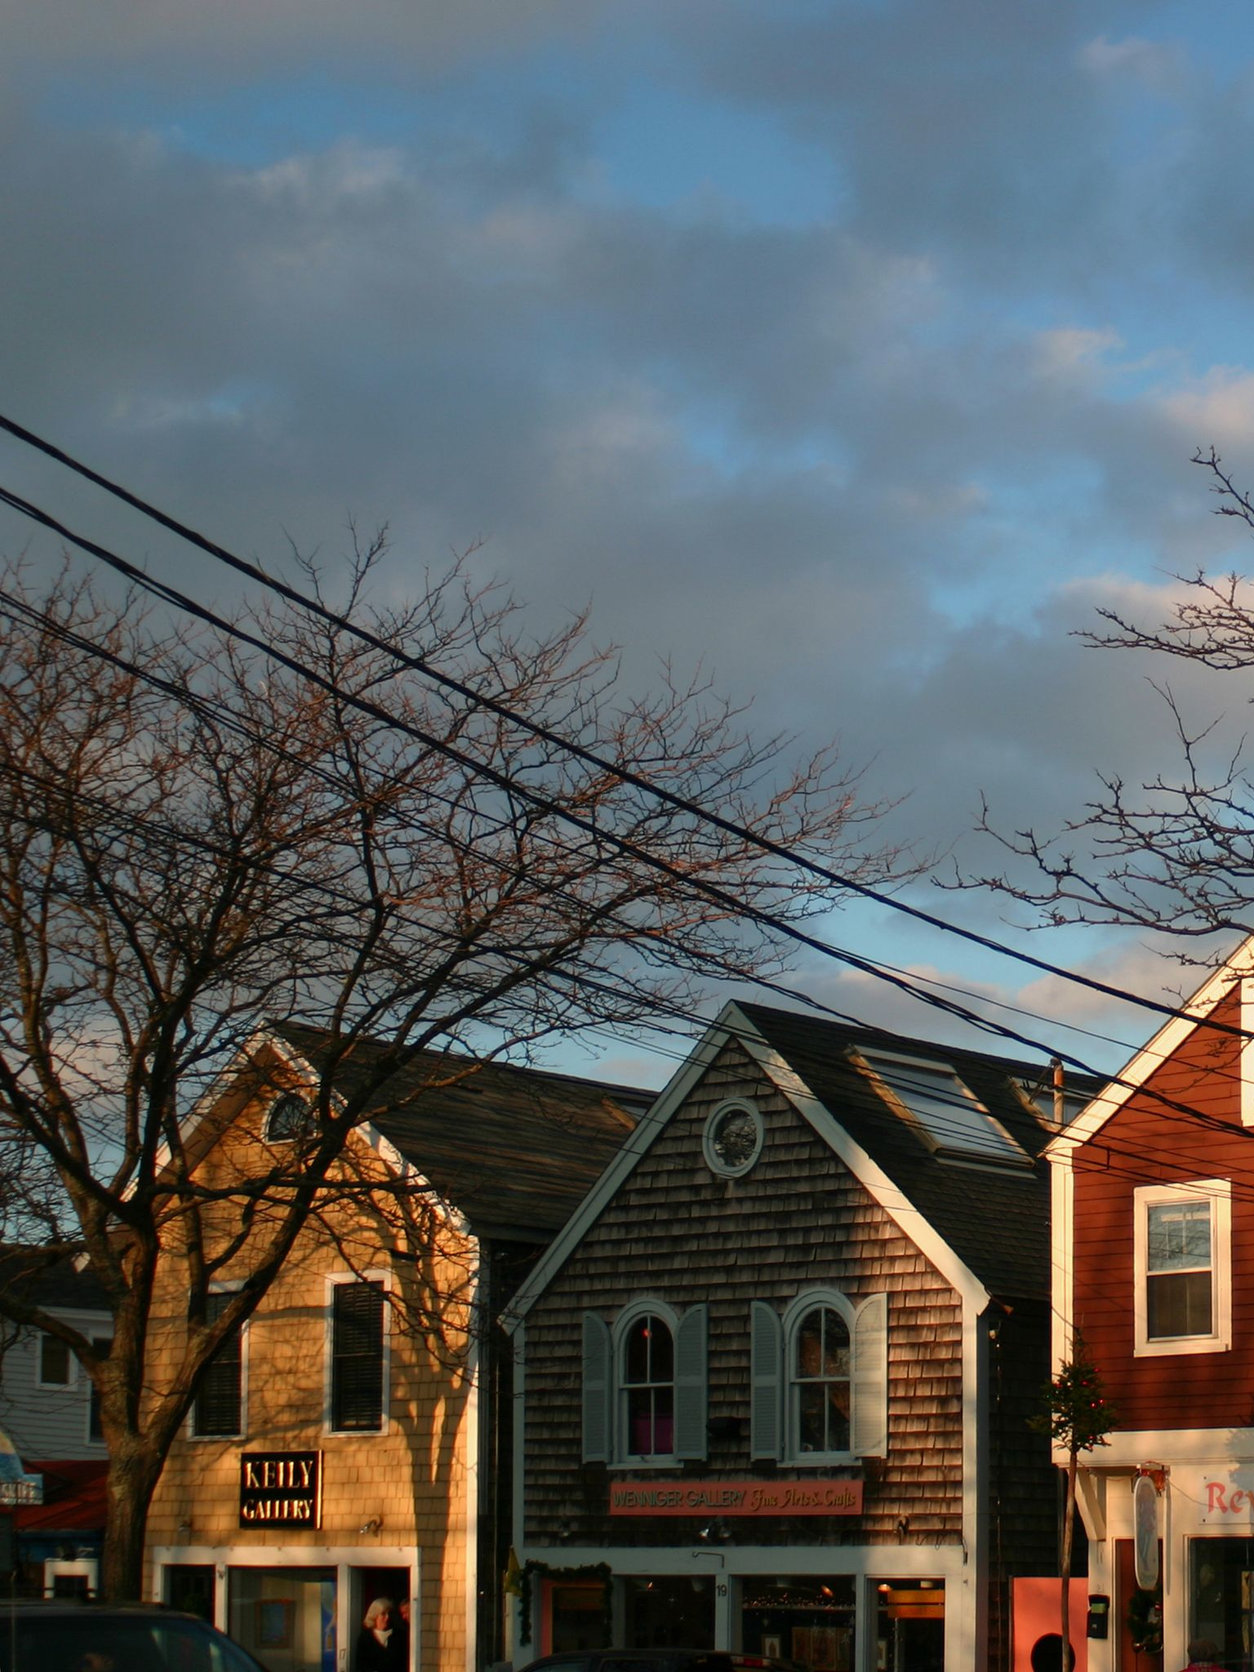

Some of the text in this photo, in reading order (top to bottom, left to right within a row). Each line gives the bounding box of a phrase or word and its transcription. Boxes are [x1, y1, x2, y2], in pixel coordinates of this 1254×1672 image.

[613, 1489, 683, 1508] WENNIGER
[686, 1489, 747, 1508] GALLERY
[242, 1499, 314, 1520] GALLERY
[717, 1584, 728, 1597] 19
